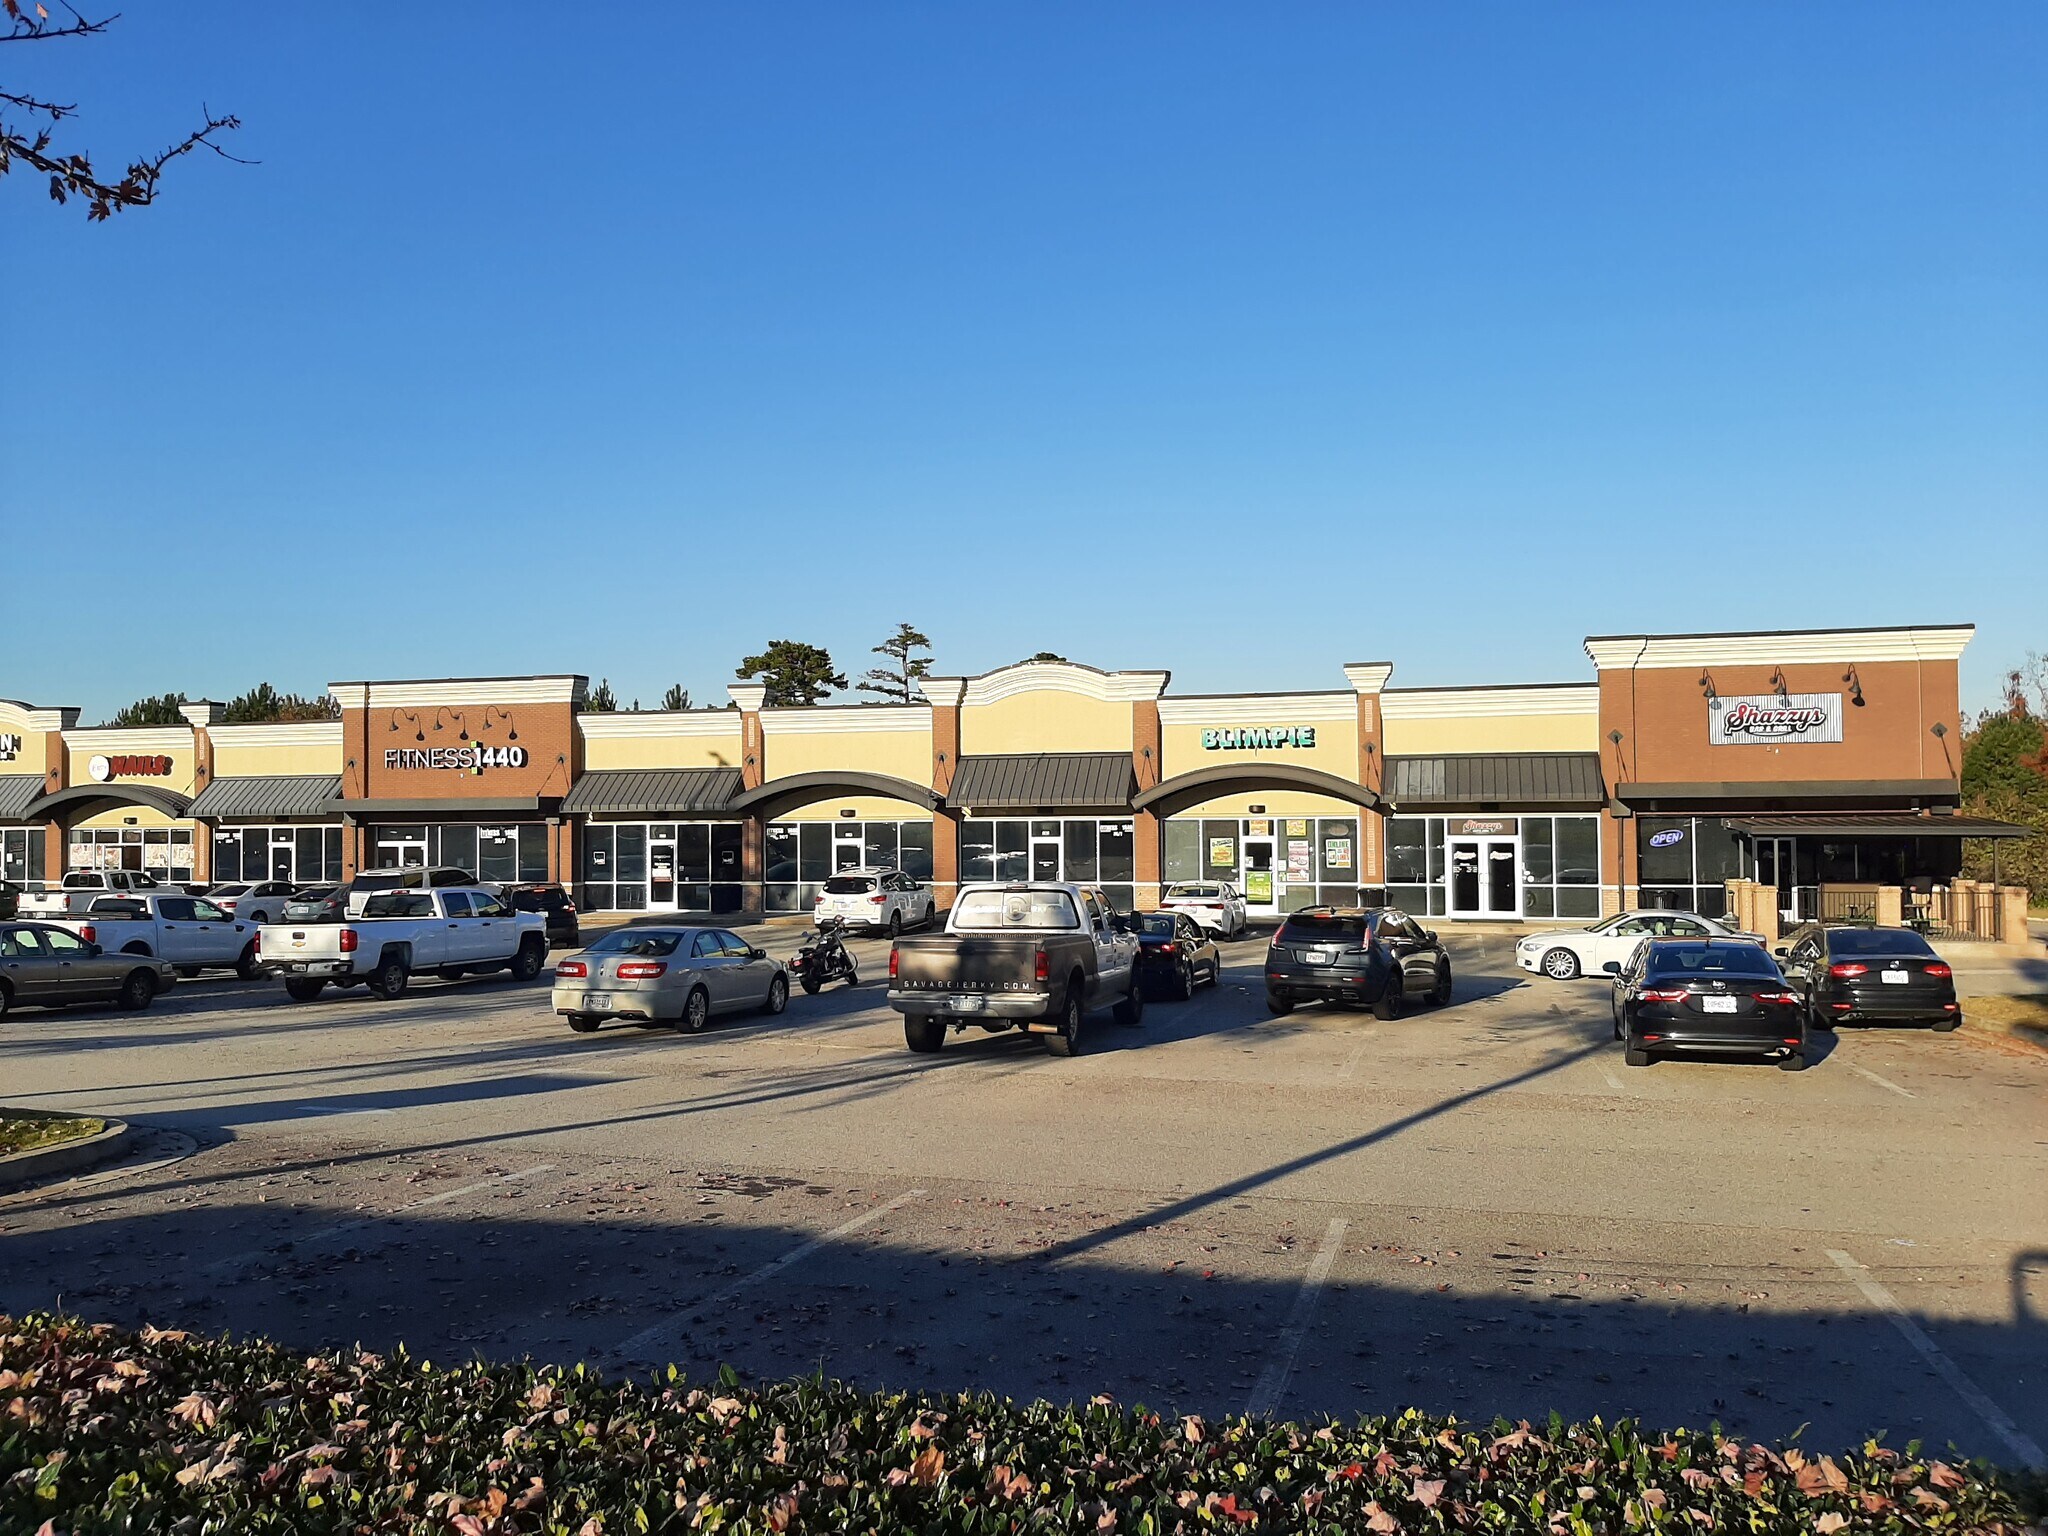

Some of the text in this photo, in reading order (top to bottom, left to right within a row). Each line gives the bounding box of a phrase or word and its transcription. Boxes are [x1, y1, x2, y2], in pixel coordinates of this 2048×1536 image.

[1725, 702, 1827, 735] Shazzys
[1201, 726, 1315, 748] BLIMPIE
[111, 755, 167, 775] NAILS
[1652, 832, 1680, 844] OPEN
